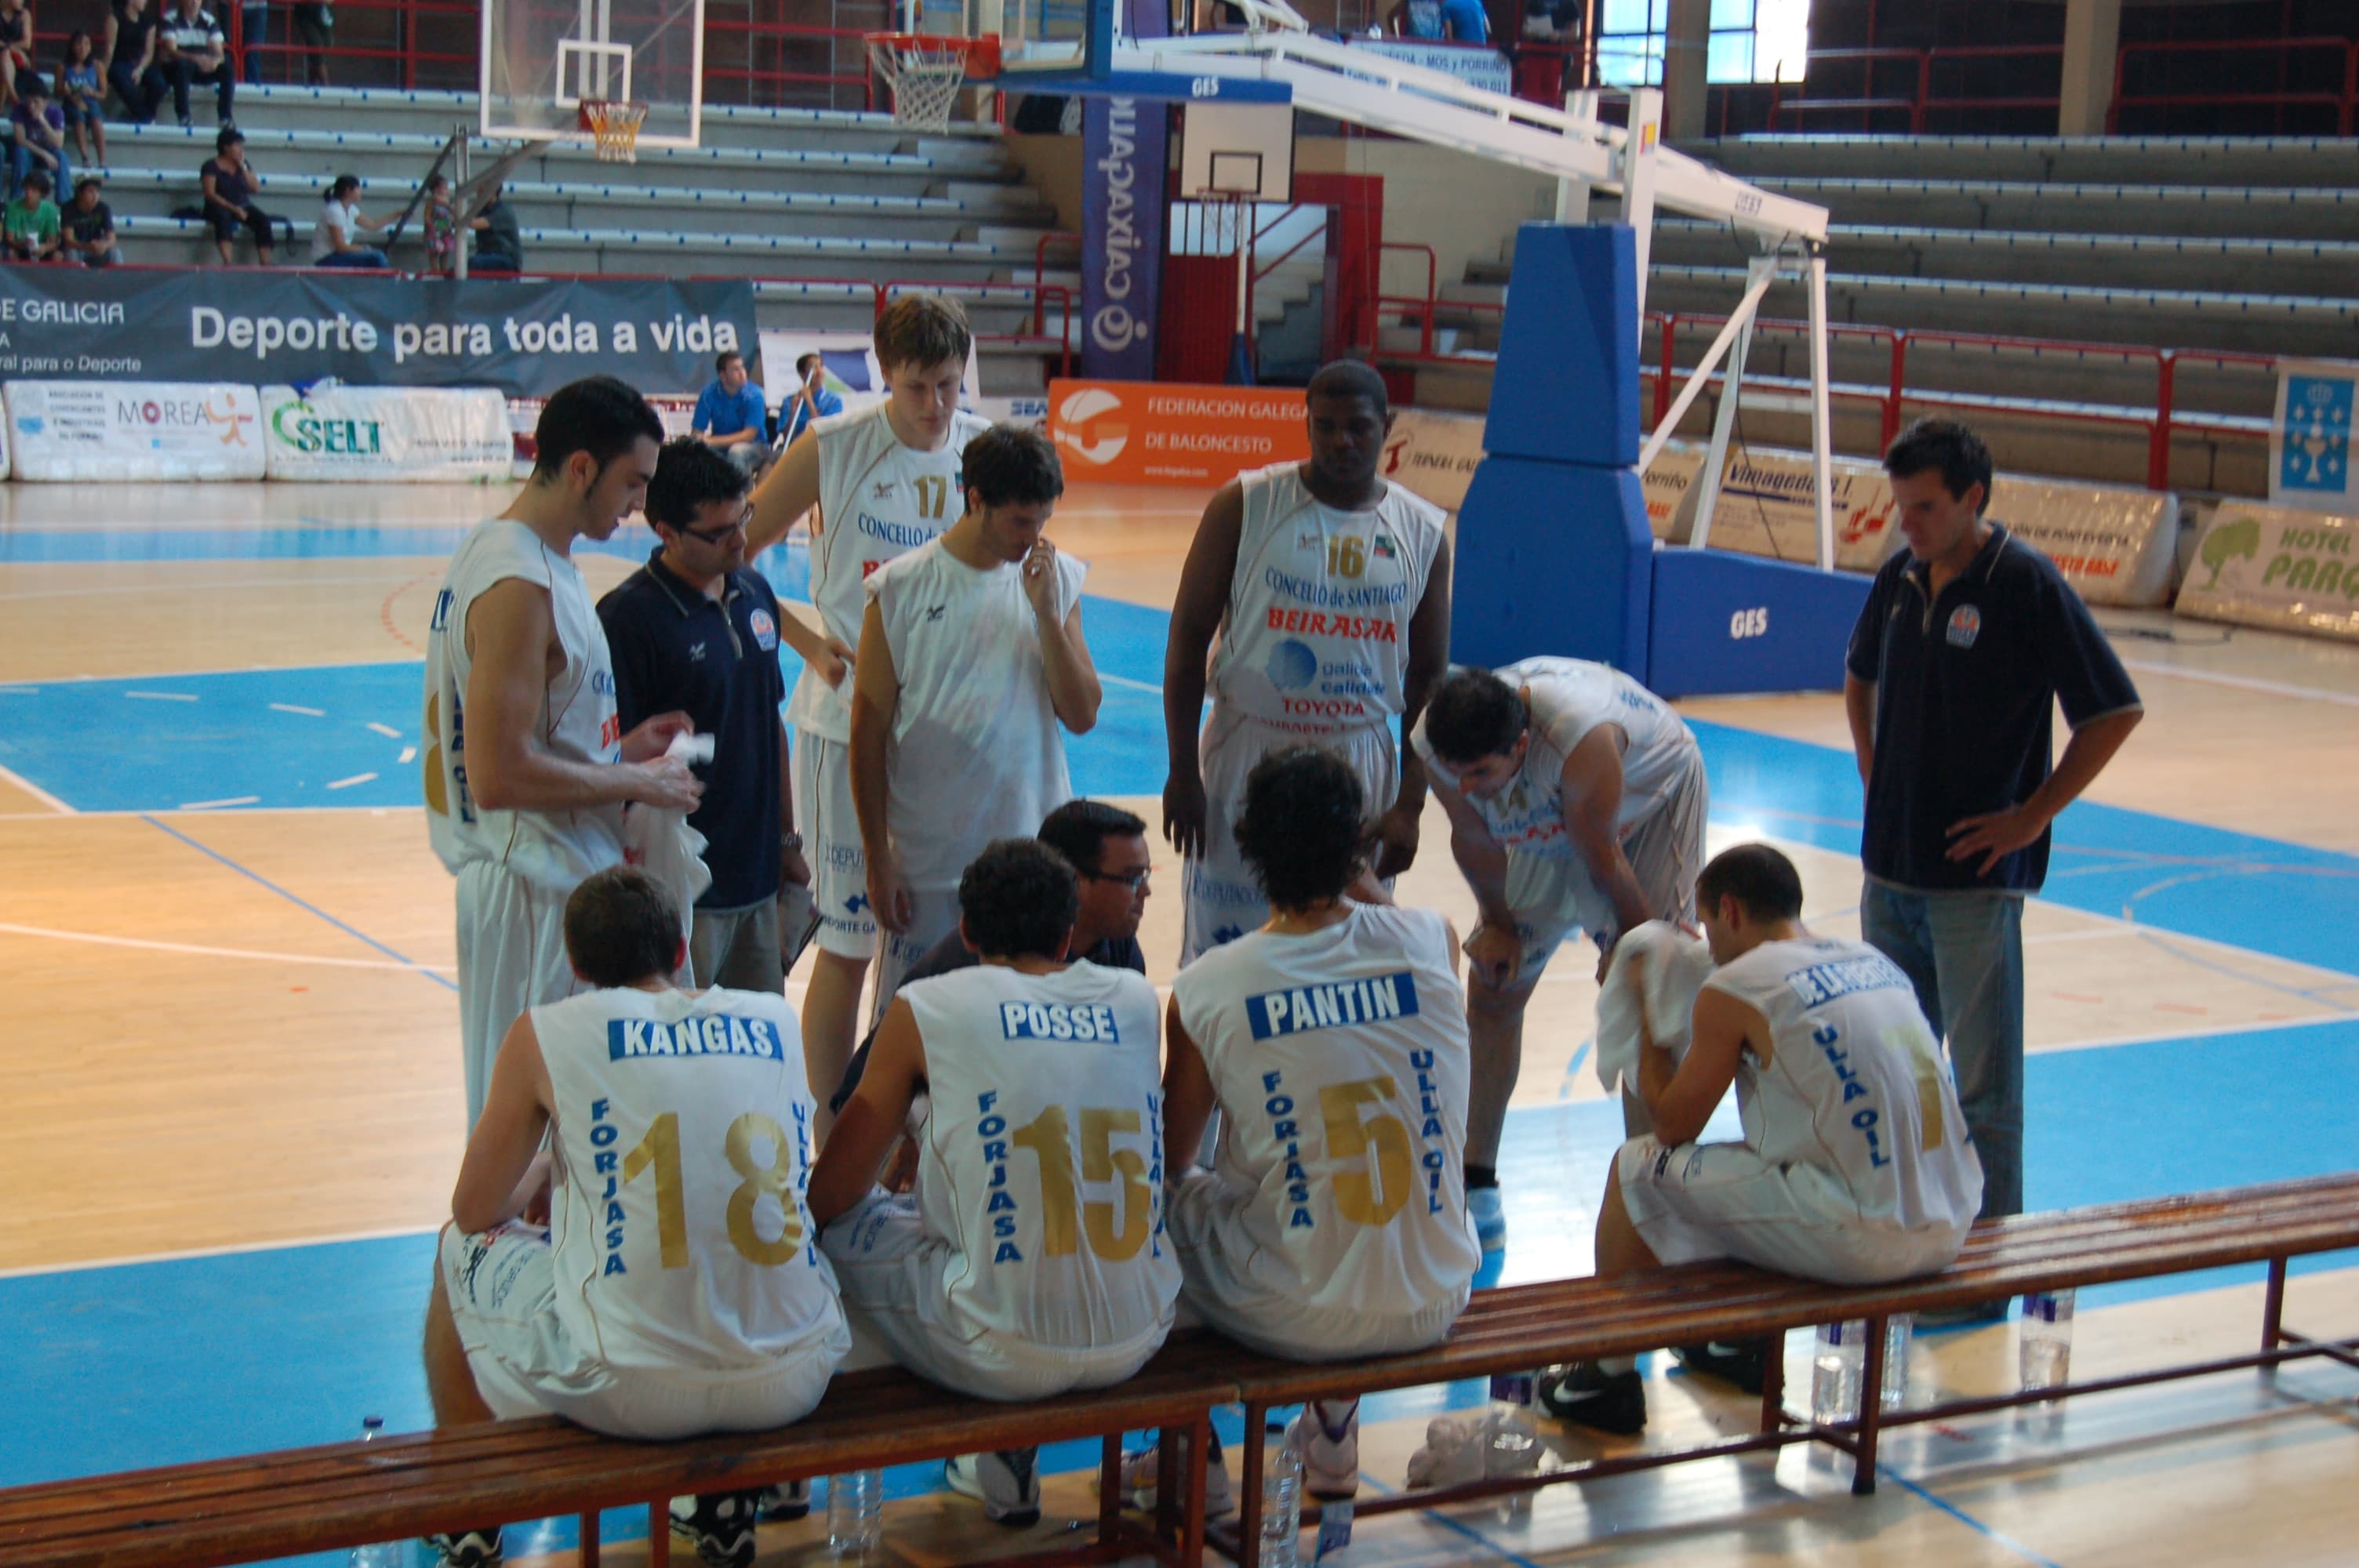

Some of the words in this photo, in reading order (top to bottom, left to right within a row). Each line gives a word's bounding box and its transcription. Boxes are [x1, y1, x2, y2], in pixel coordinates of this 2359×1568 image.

[0, 299, 16, 321] E
[22, 299, 124, 324] GALICIA
[192, 307, 377, 360] Deporte
[394, 322, 493, 363] para
[503, 314, 598, 353] toda
[612, 321, 637, 353] a
[650, 314, 739, 353] vida
[22, 361, 59, 374] para
[64, 361, 75, 372] o
[78, 355, 142, 375] Deporte
[118, 401, 210, 425] MOREA
[296, 419, 382, 453] SELT
[1145, 432, 1167, 449] DE
[1172, 434, 1273, 454] BALONCESTO
[913, 476, 947, 518] 17
[858, 512, 923, 547] CONCELLO
[2280, 527, 2352, 555] HOTEL
[1328, 534, 1365, 578] 16
[1266, 565, 1329, 604] CONCELLO
[1330, 586, 1345, 608] de
[1347, 582, 1407, 608] SANTIAGO
[1730, 607, 1768, 640] GES
[1282, 696, 1365, 717] TOYOTA
[1005, 1003, 1114, 1043] POSSE
[1264, 975, 1401, 1036] PANTIN
[623, 1016, 774, 1058] KANGAS
[1409, 1047, 1444, 1140] ULLA
[1812, 1023, 1870, 1105] ULLA
[1851, 1107, 1891, 1171] OIL
[1262, 1070, 1314, 1229] FORJASA
[1318, 1075, 1412, 1227] 5
[591, 1098, 627, 1277] FORJASA
[623, 1112, 803, 1269] 18
[977, 1089, 1023, 1265] FORJASA
[1012, 1104, 1151, 1262] 15
[1422, 1149, 1444, 1217] OIL
